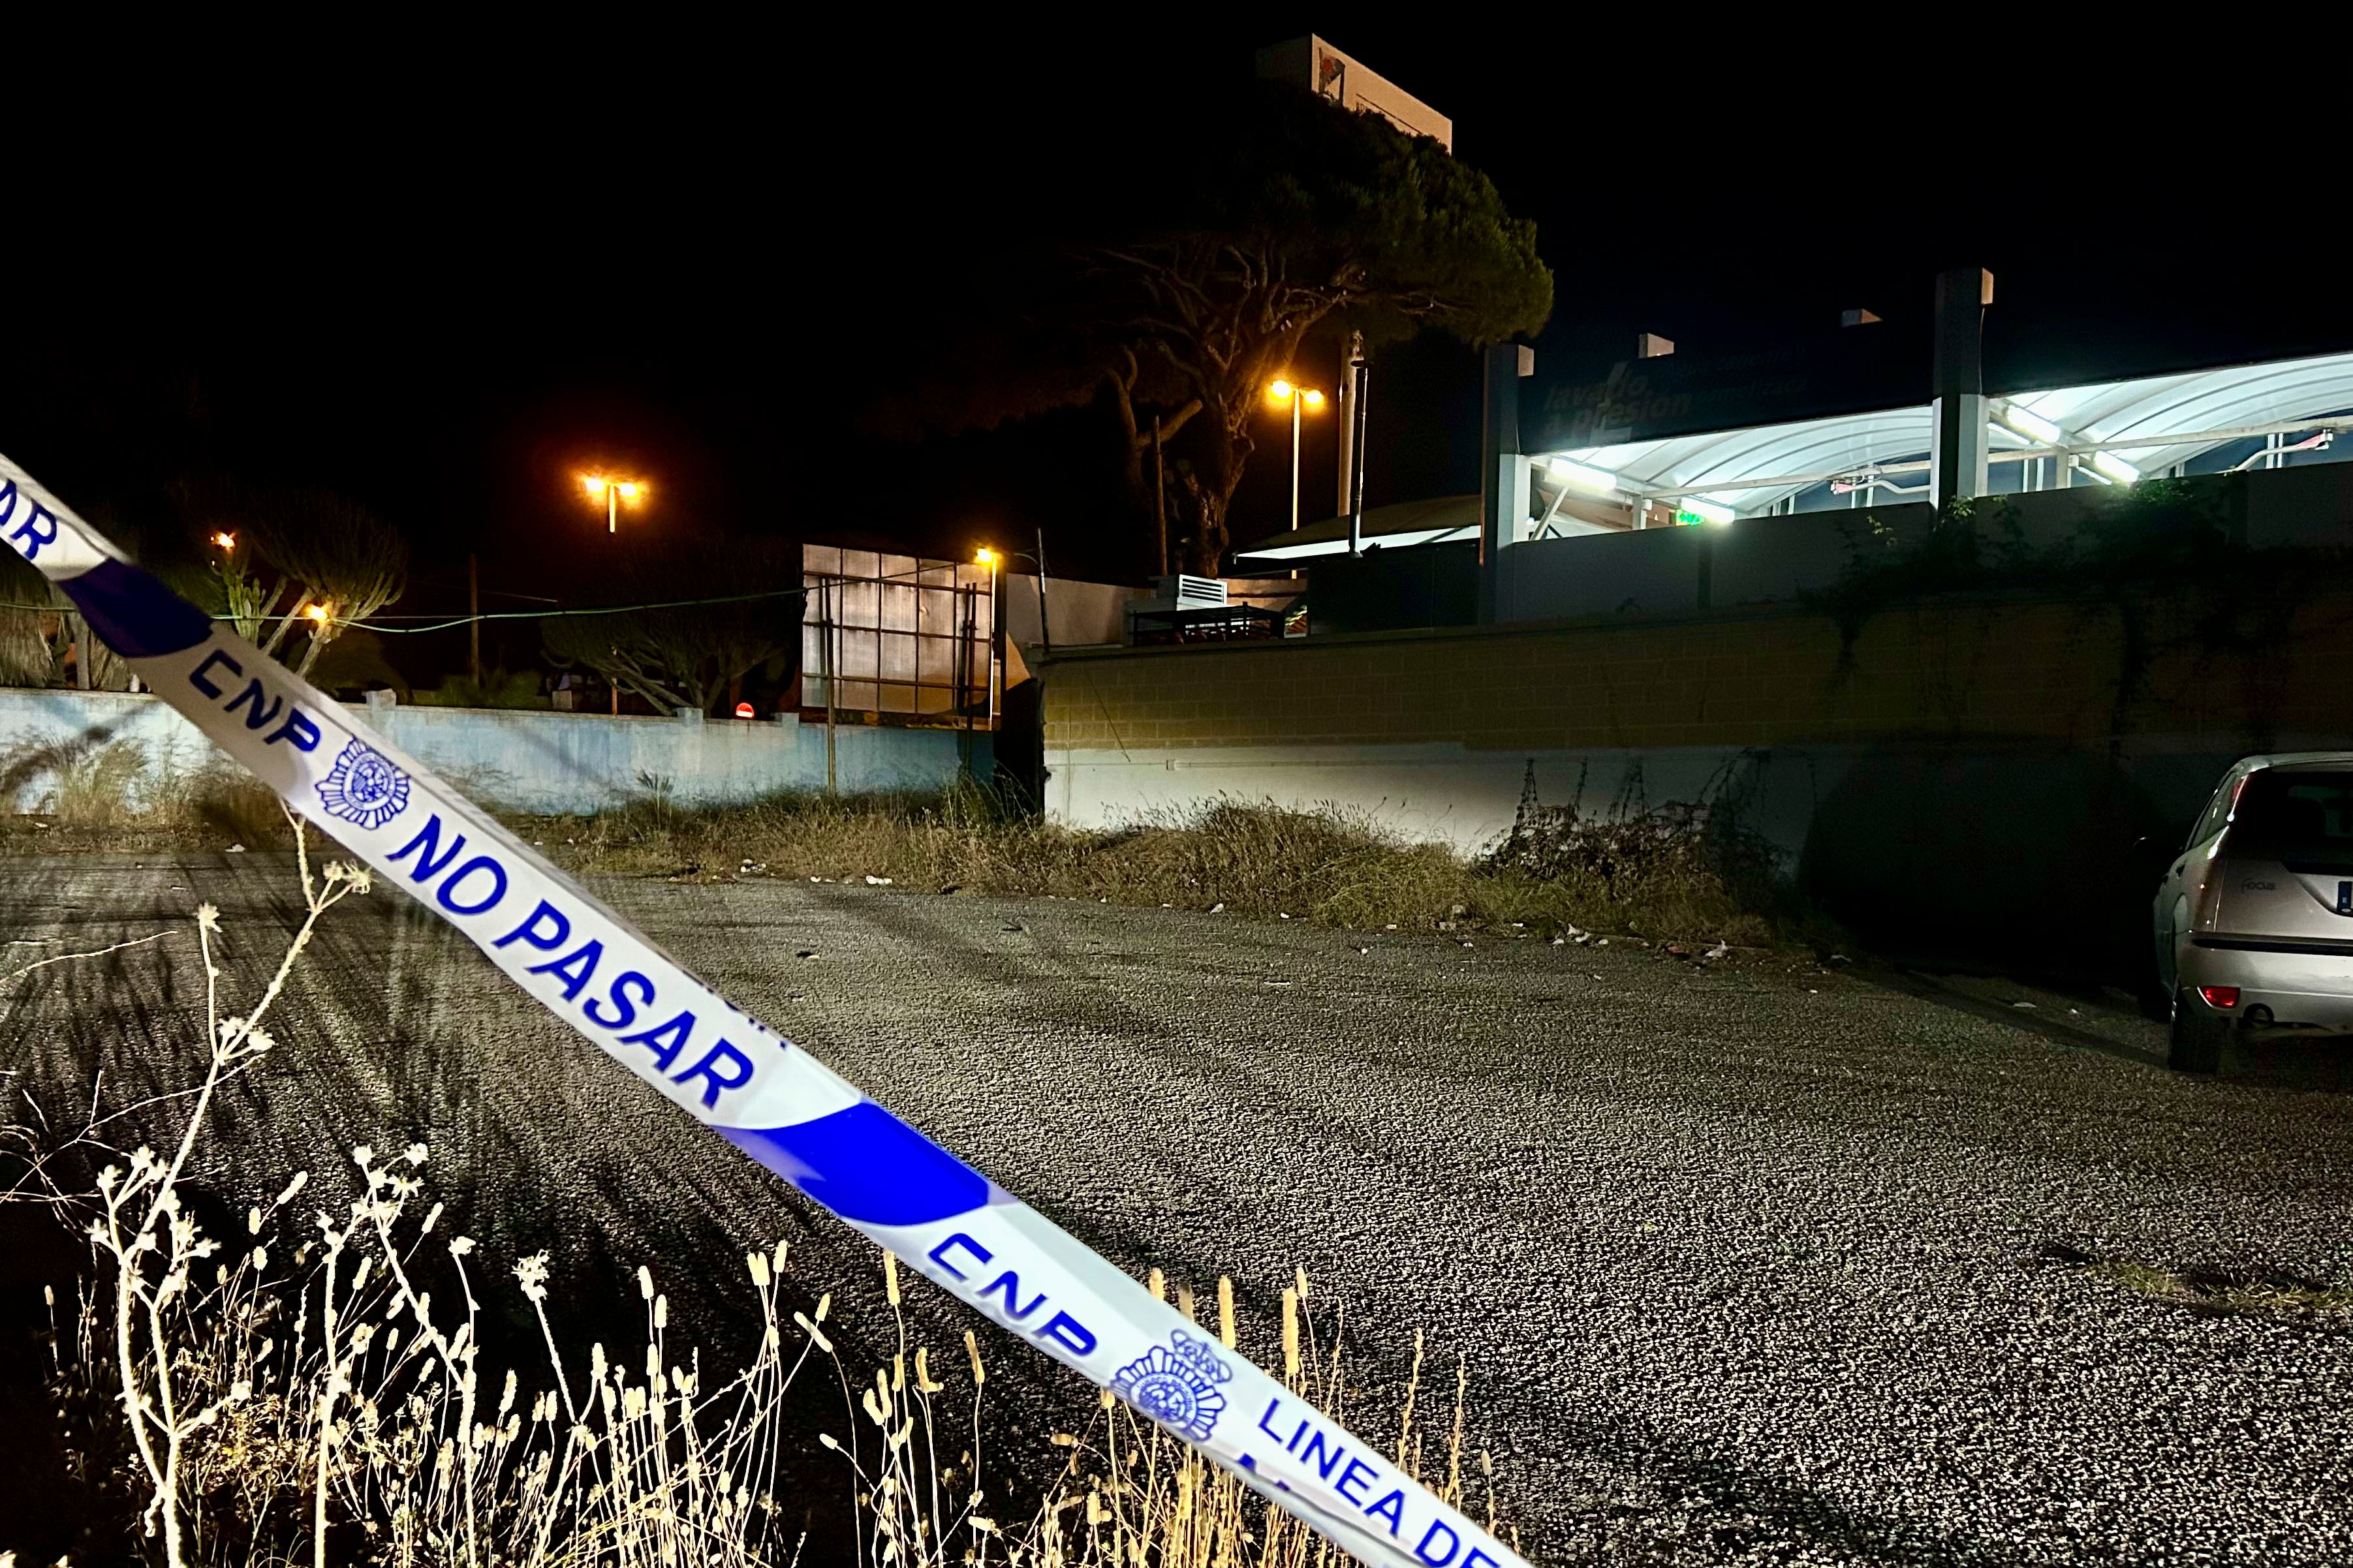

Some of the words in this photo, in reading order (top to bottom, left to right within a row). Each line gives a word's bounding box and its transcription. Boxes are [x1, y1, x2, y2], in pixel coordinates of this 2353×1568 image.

[188, 649, 322, 754] CNP
[386, 813, 508, 917] NO
[491, 899, 755, 1109] PASAR
[927, 1233, 1098, 1357] CNP
[1256, 1397, 1405, 1539] LINEA
